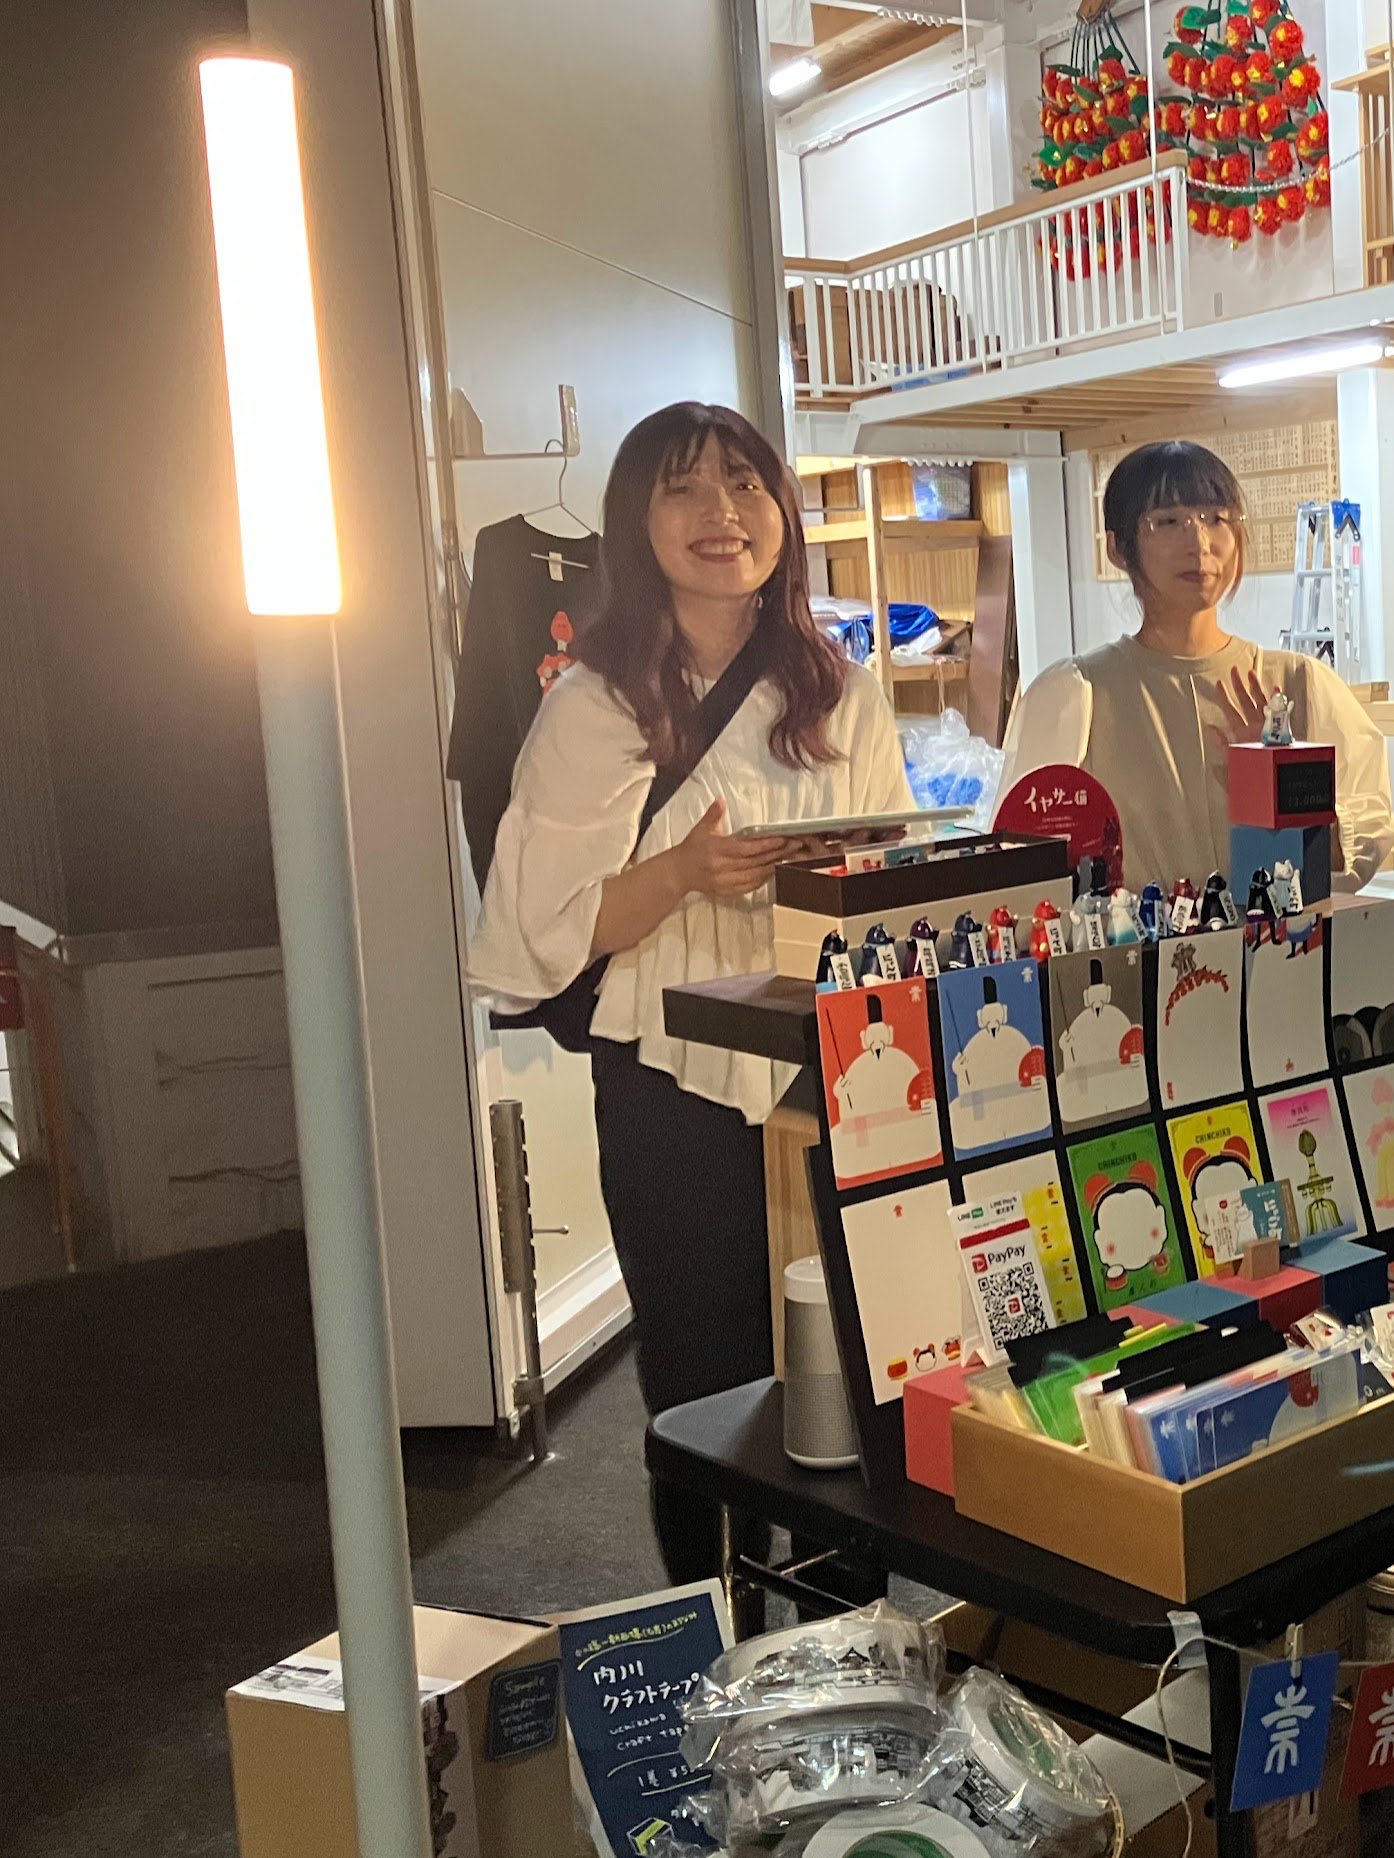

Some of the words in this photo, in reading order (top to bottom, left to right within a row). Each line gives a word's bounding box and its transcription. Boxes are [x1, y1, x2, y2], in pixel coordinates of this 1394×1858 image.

[988, 1245, 1026, 1265] PayPay
[593, 1660, 645, 1685] 内川
[603, 1672, 700, 1714] クラフトテープ
